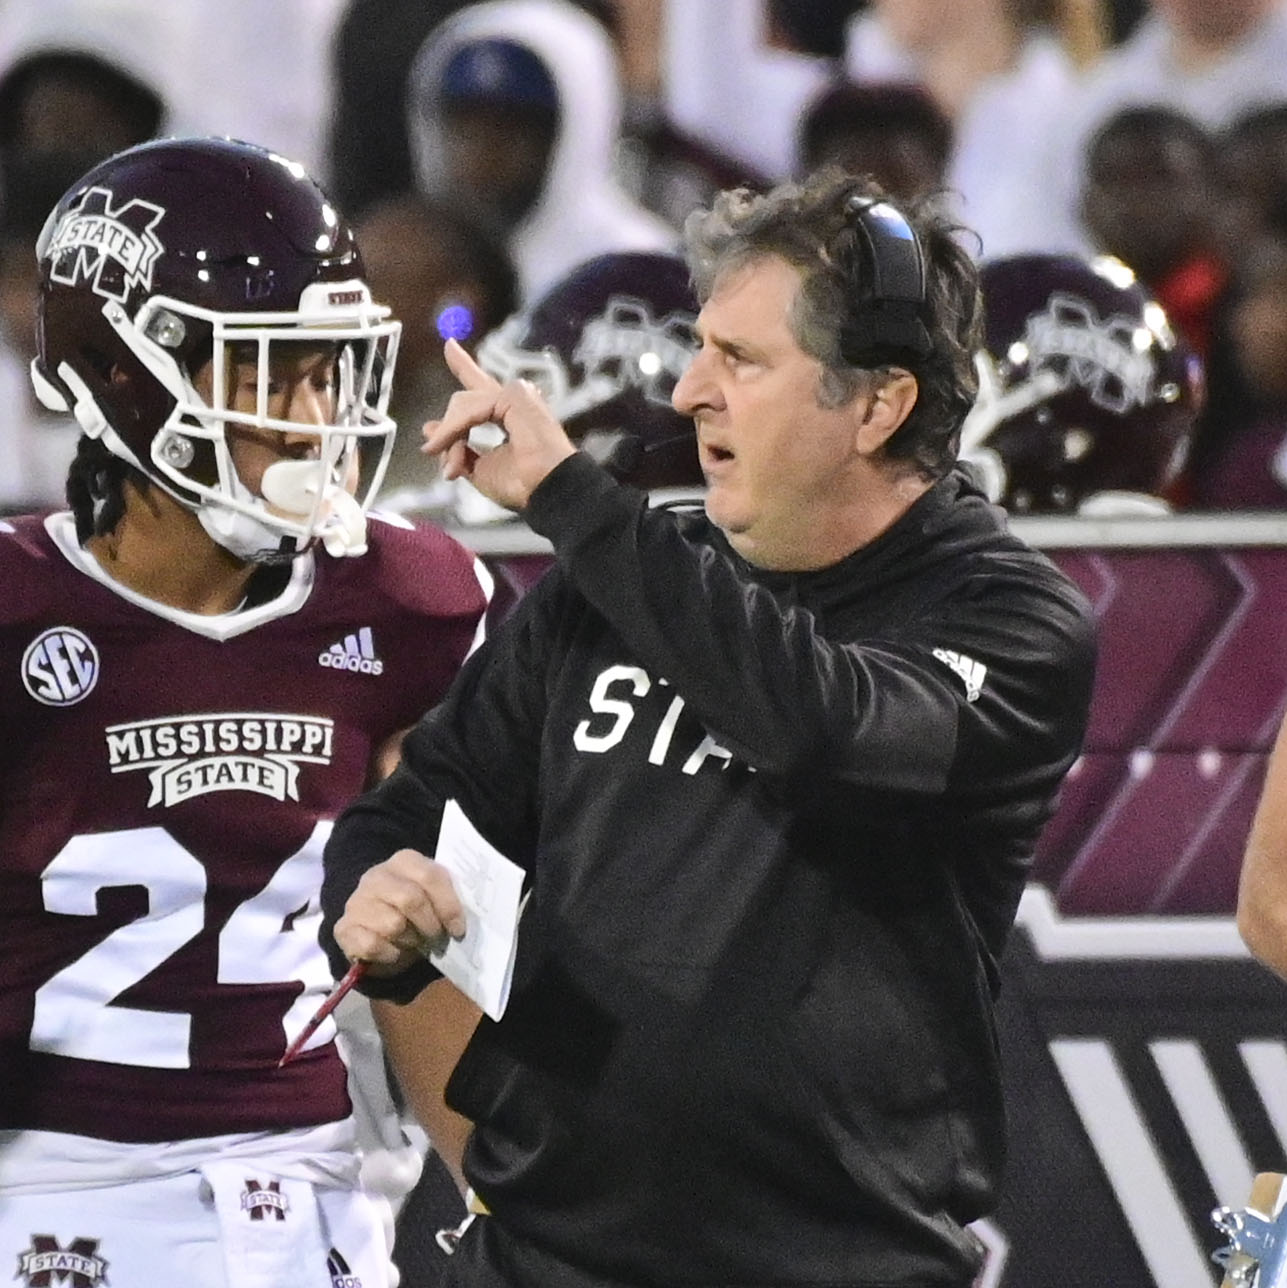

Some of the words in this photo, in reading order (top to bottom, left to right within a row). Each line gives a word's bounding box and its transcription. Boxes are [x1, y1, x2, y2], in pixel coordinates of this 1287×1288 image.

[66, 219, 136, 263] STATE
[28, 633, 93, 700] SEC
[318, 652, 383, 676] adidas
[106, 721, 334, 765] MISSISSIPPI
[175, 761, 276, 795] STATE
[35, 1254, 92, 1274] STATE
